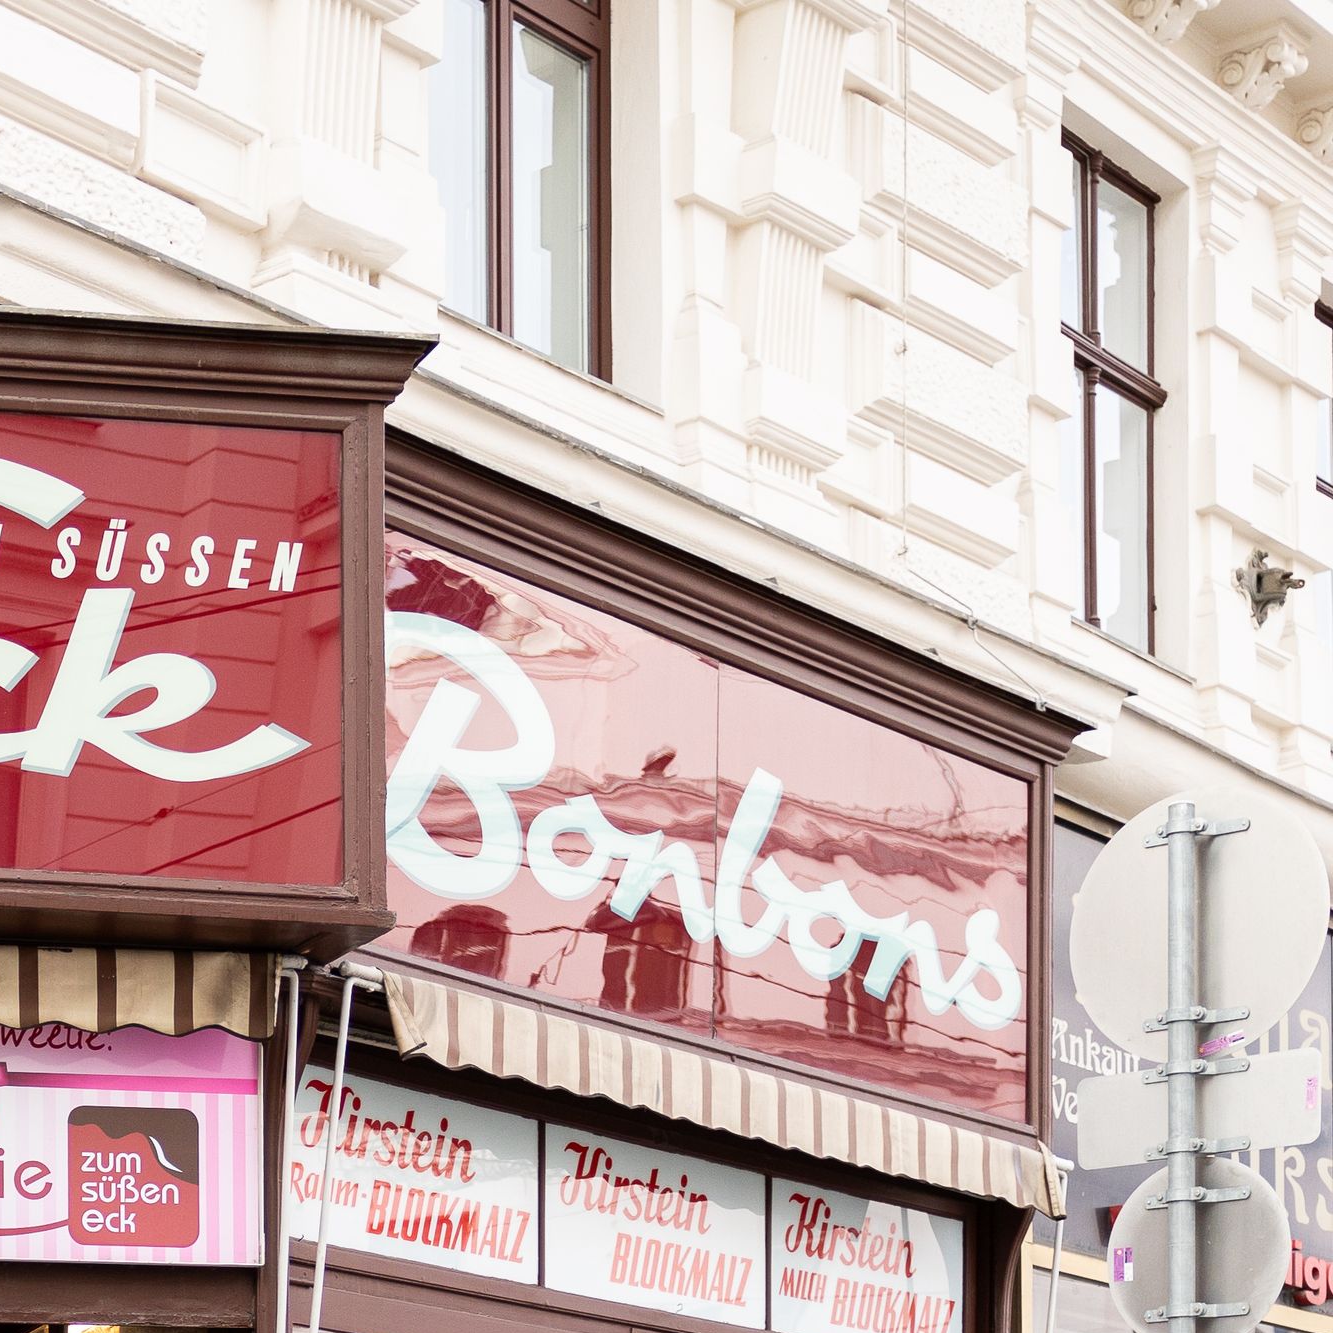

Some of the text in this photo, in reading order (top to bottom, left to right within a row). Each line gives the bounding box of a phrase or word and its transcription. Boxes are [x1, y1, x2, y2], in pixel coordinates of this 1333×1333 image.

[50, 517, 304, 593] SÜSSEN
[385, 610, 1023, 1031] Bonbons
[80, 1152, 142, 1173] zum
[300, 1079, 477, 1183] Kirstein
[81, 1175, 179, 1205] süßen
[81, 1205, 136, 1233] eck
[560, 1141, 712, 1236] Kirstein
[609, 1233, 754, 1308] BLOCKMALZ
[785, 1192, 917, 1279] Kirstein
[778, 1266, 829, 1304] MILCH
